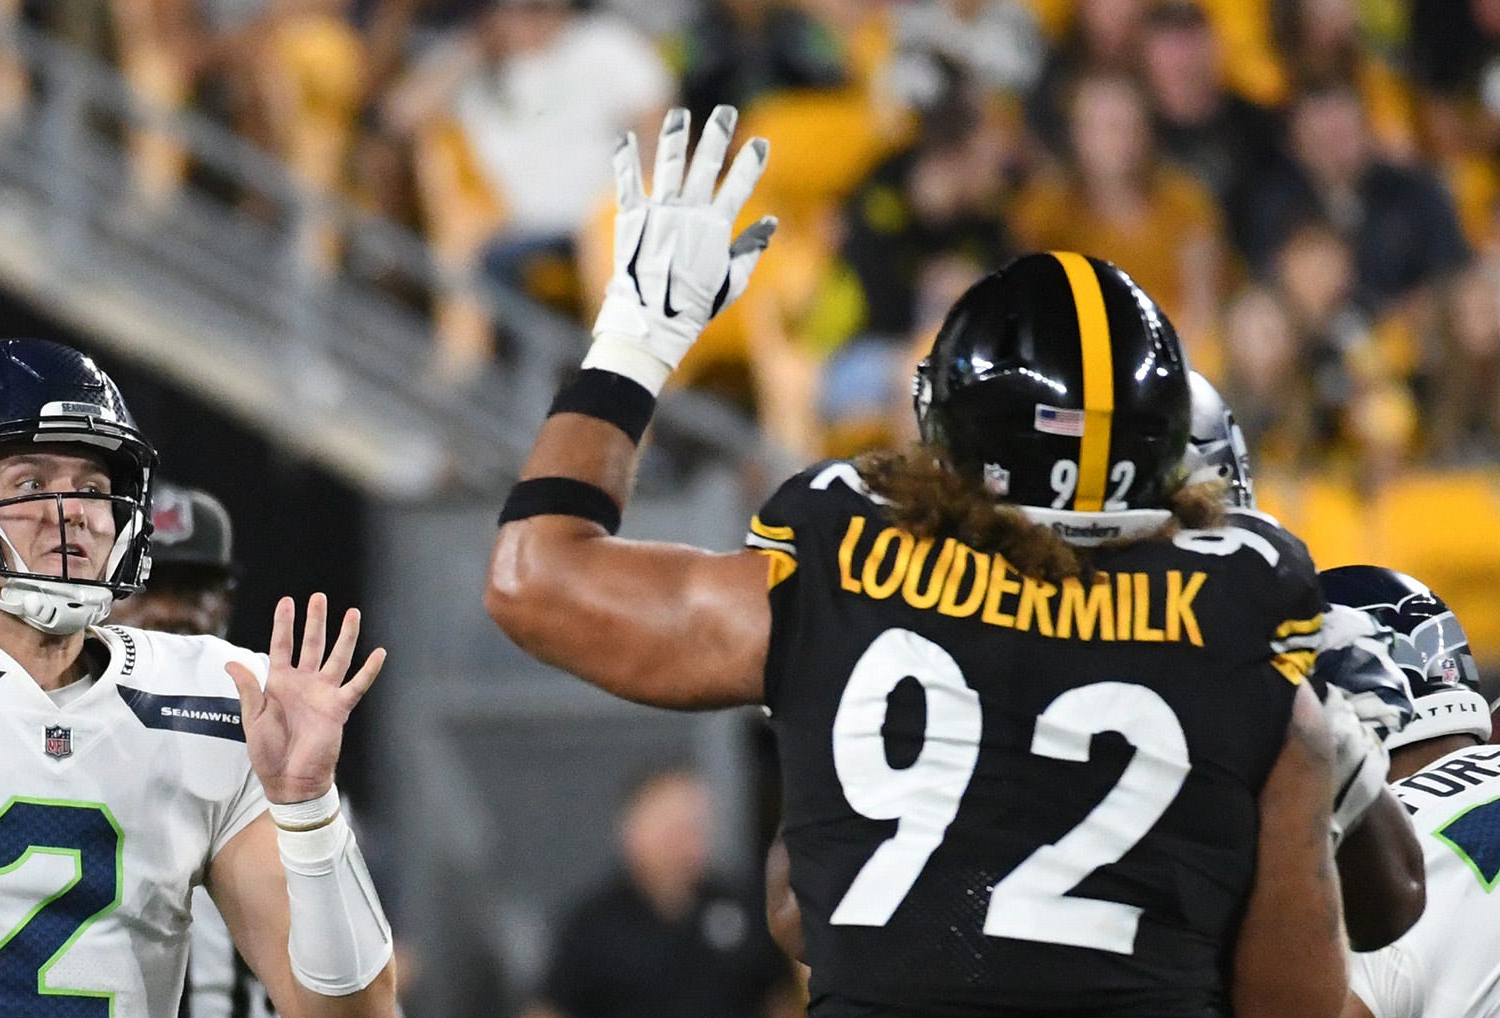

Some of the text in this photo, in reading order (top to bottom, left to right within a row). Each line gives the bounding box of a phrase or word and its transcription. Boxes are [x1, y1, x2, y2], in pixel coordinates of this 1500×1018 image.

[1051, 459, 1136, 513] 92
[838, 516, 1207, 647] LOUDERMILK
[161, 706, 241, 725] SEAHAWKS
[1411, 703, 1477, 722] ATTLE
[829, 628, 1192, 955] 92
